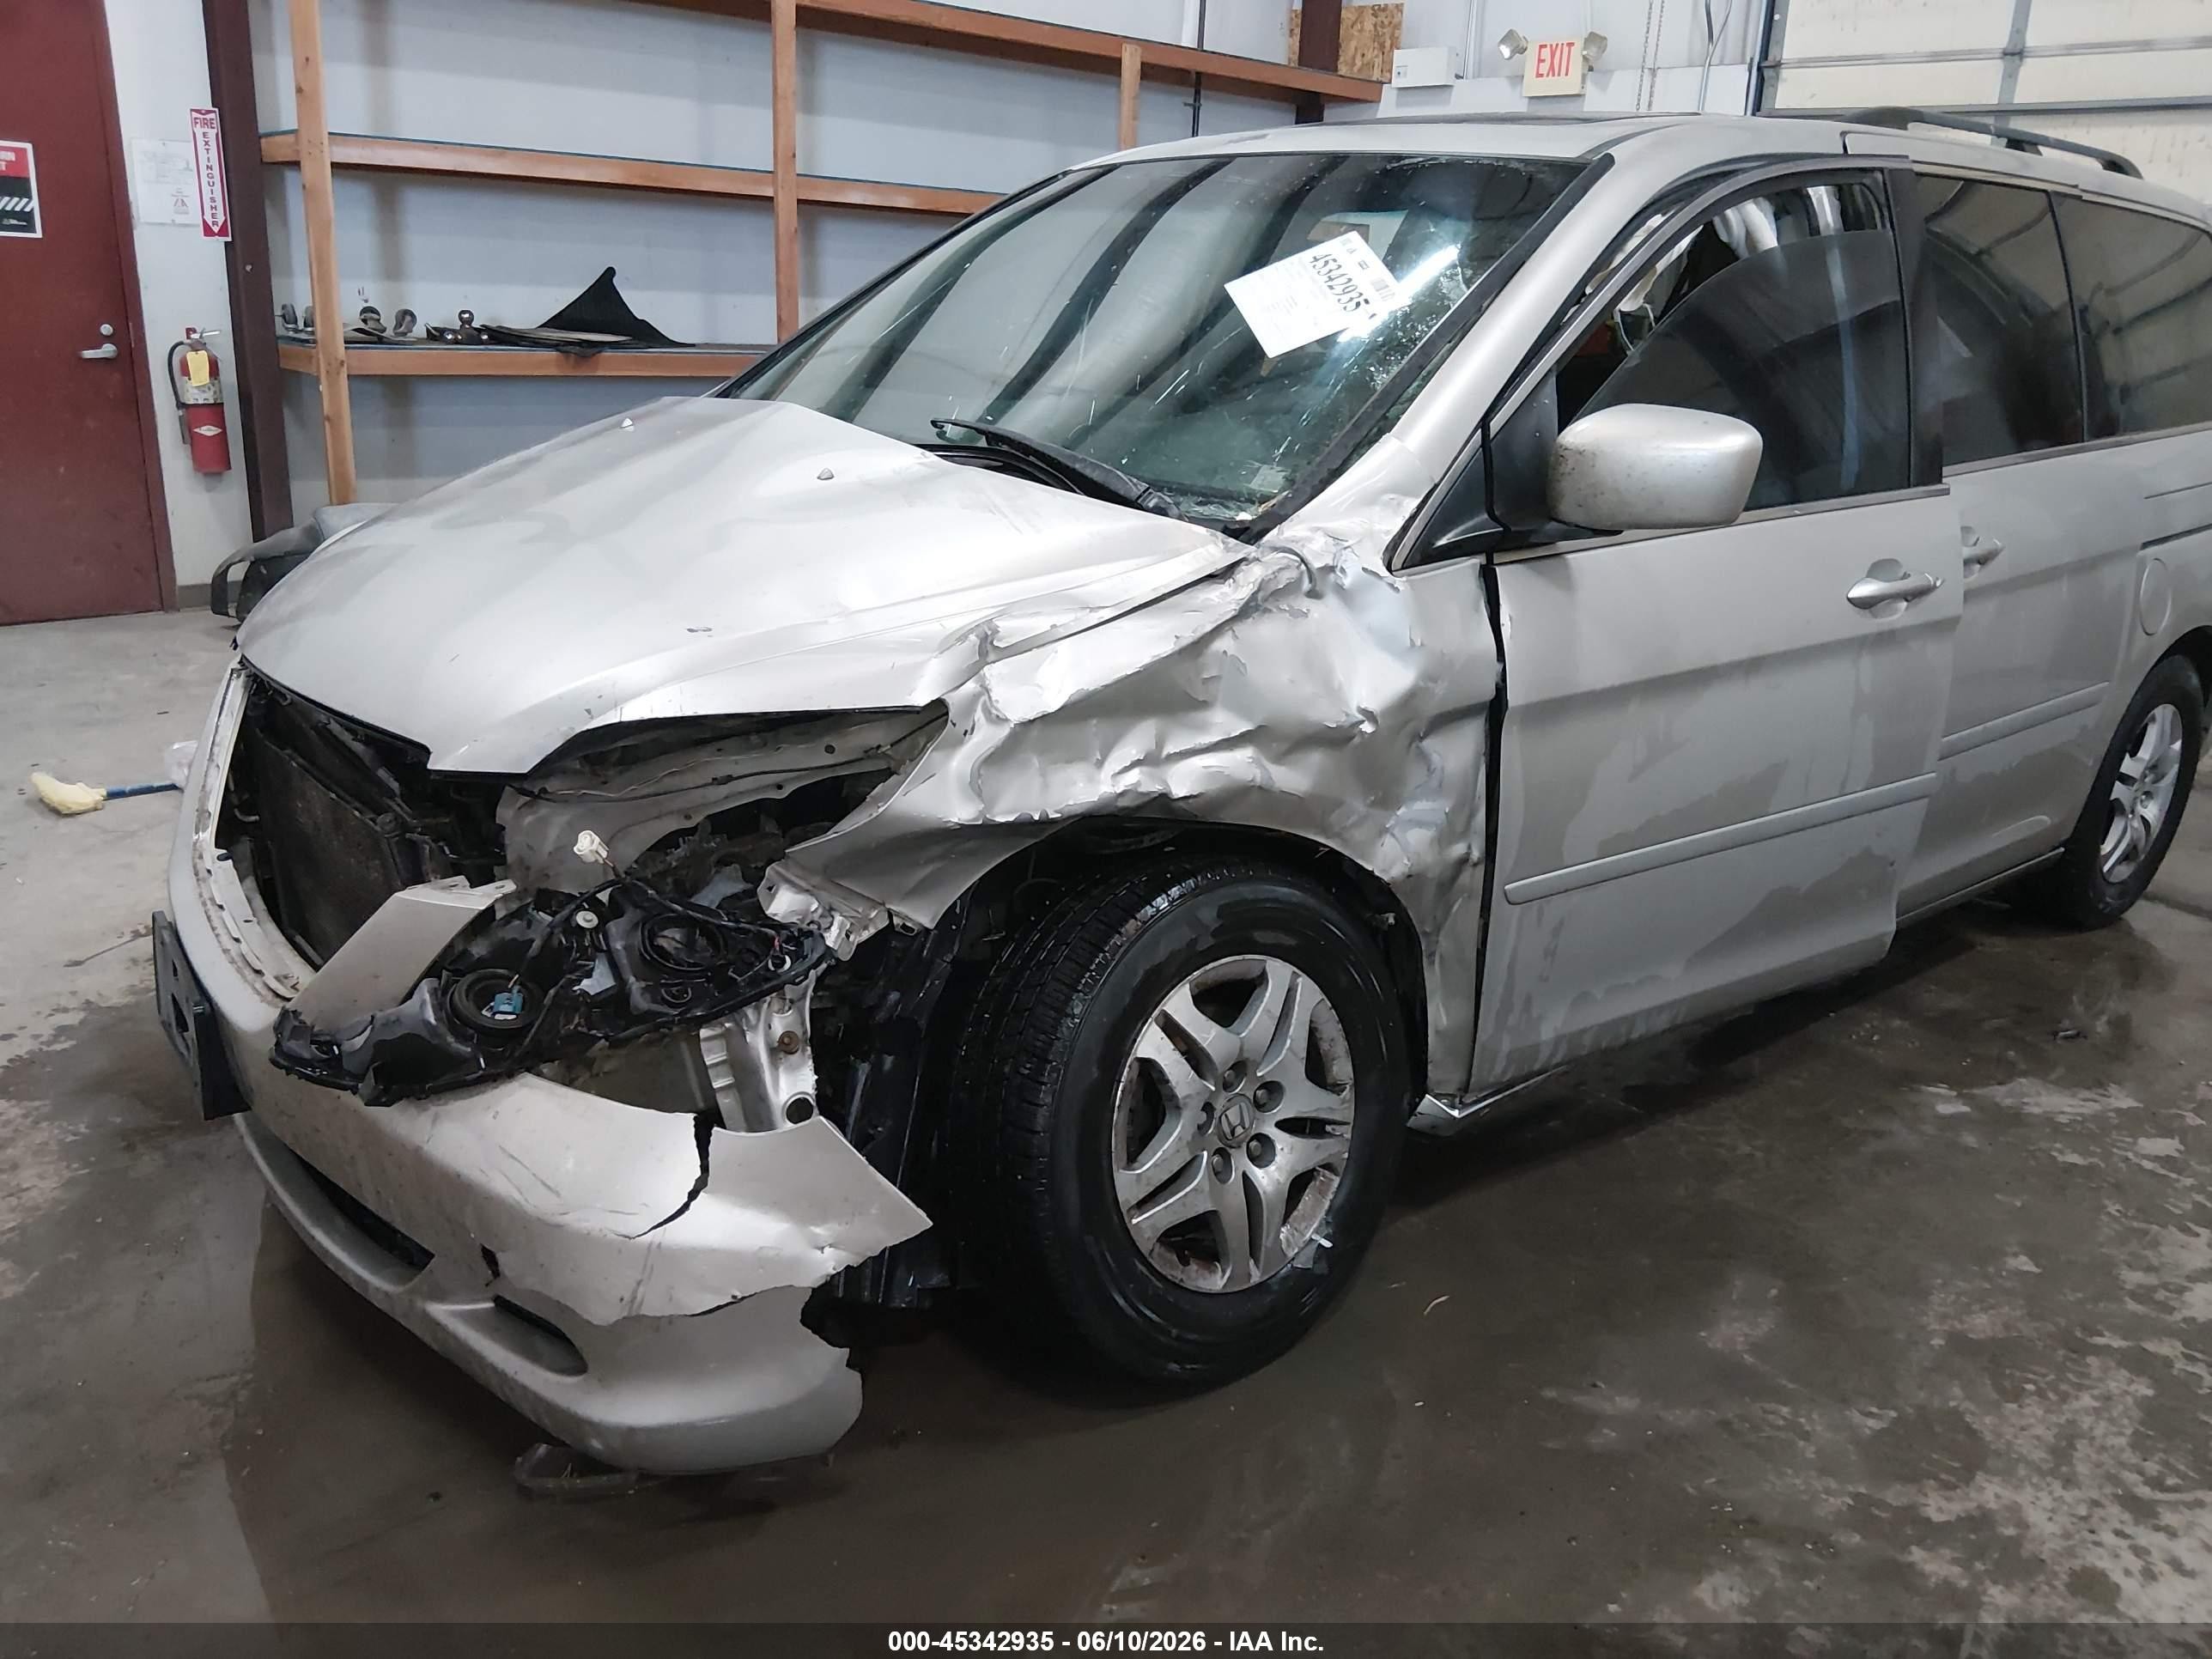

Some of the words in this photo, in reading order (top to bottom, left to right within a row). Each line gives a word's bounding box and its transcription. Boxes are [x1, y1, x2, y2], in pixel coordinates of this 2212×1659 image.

[1535, 42, 1575, 78] EXIT
[193, 117, 216, 130] FIRE
[202, 131, 219, 228] EXTINGUISHER
[1309, 253, 1370, 313] 45342935
